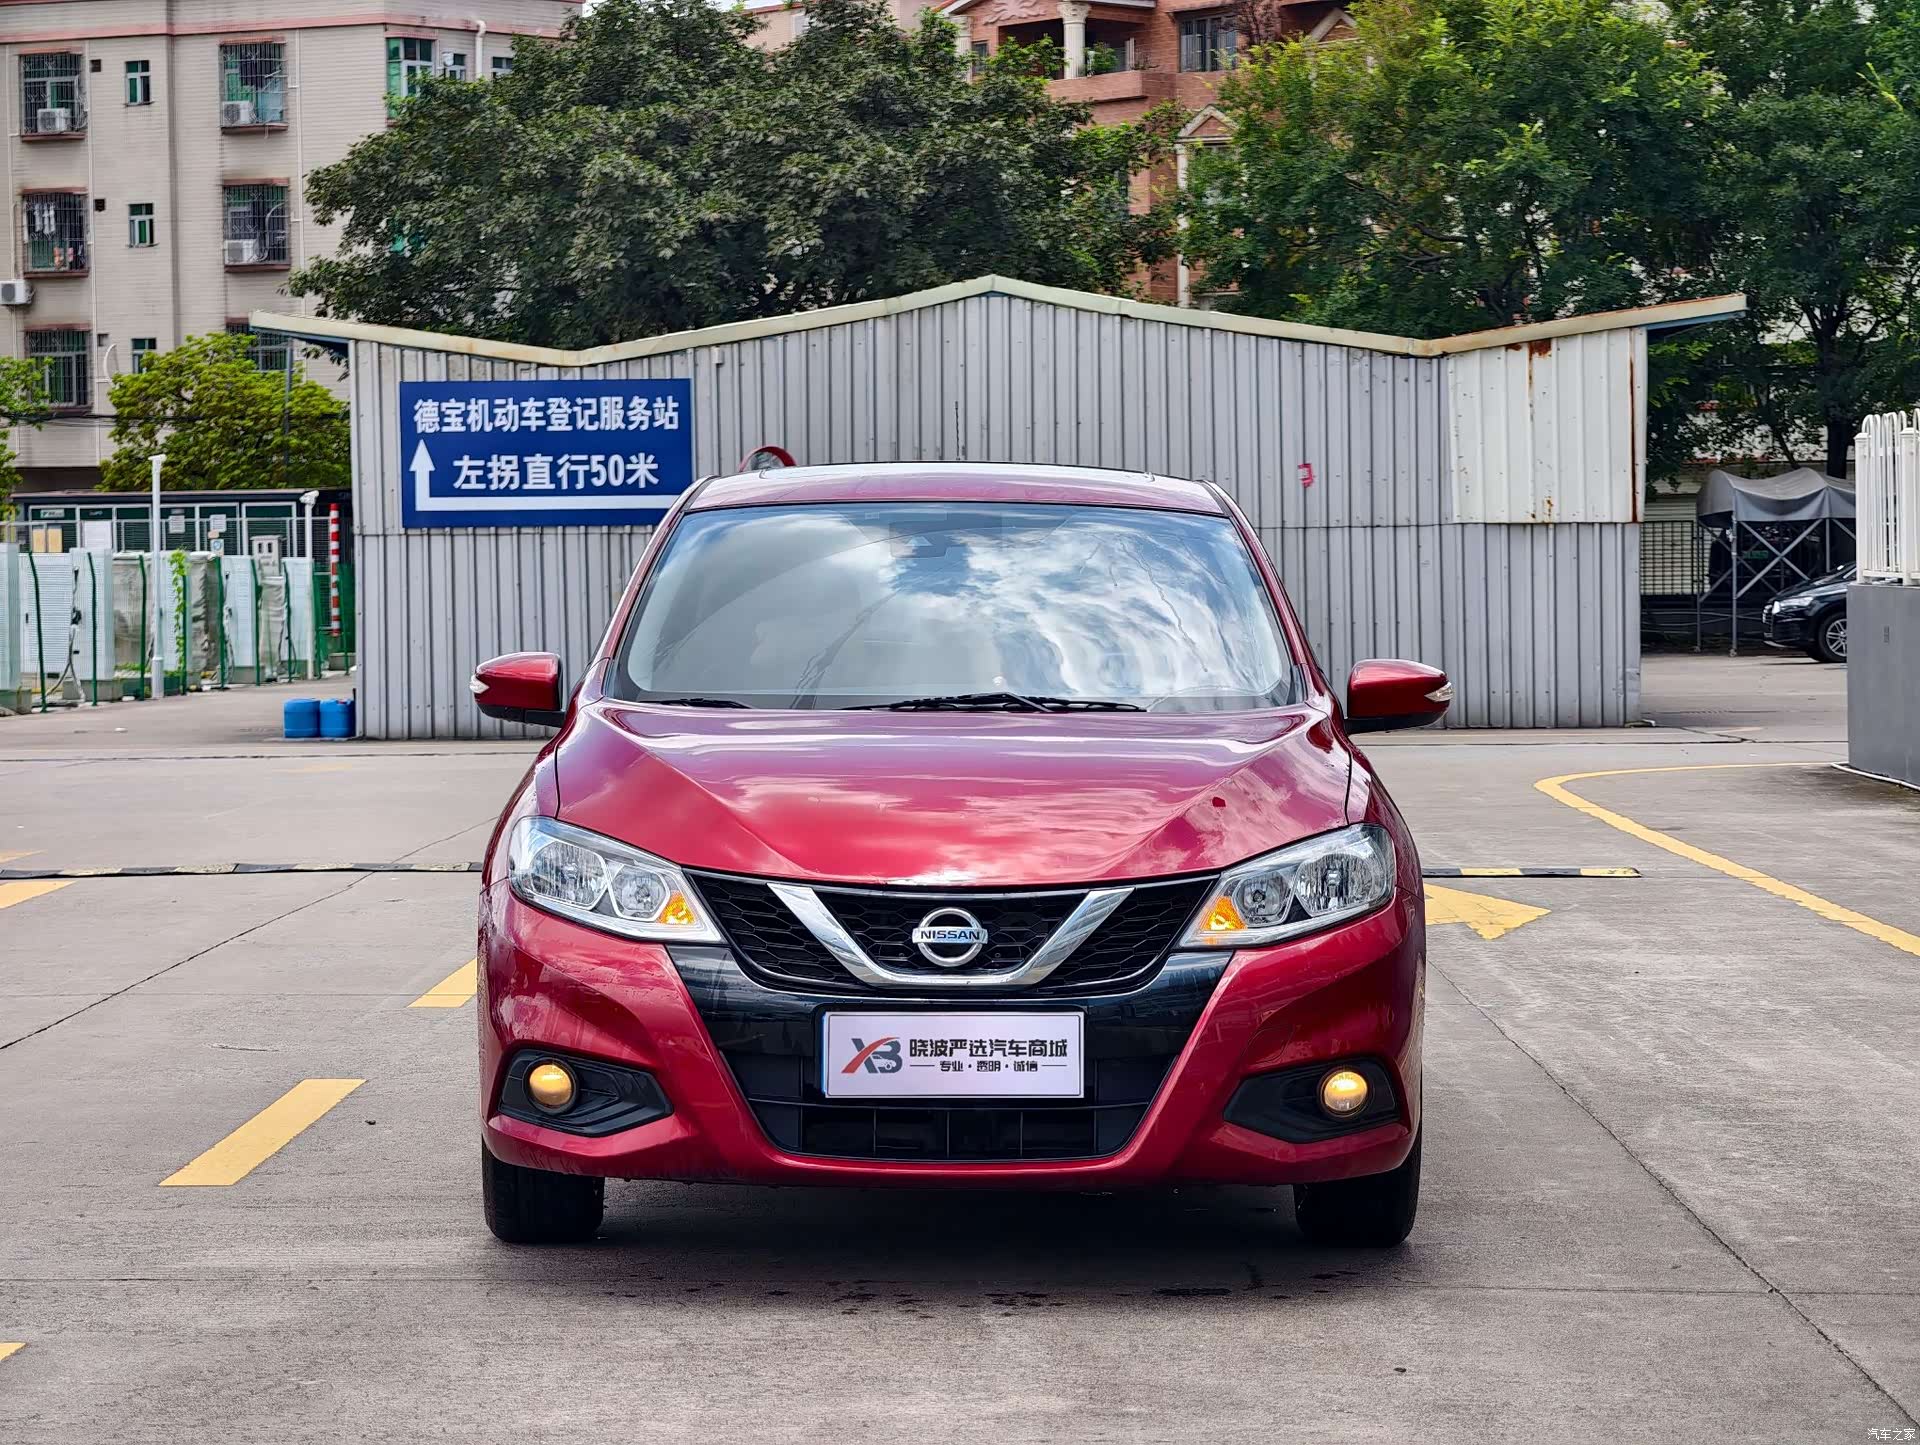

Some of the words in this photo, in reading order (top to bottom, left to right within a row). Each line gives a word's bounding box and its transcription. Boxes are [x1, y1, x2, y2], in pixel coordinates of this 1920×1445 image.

[413, 395, 679, 433] 德宝机动车登记服务站
[453, 452, 659, 490] 左拐直行50米
[920, 930, 980, 941] NISSAN
[909, 1039, 1068, 1057] 晓波严选汽车商城
